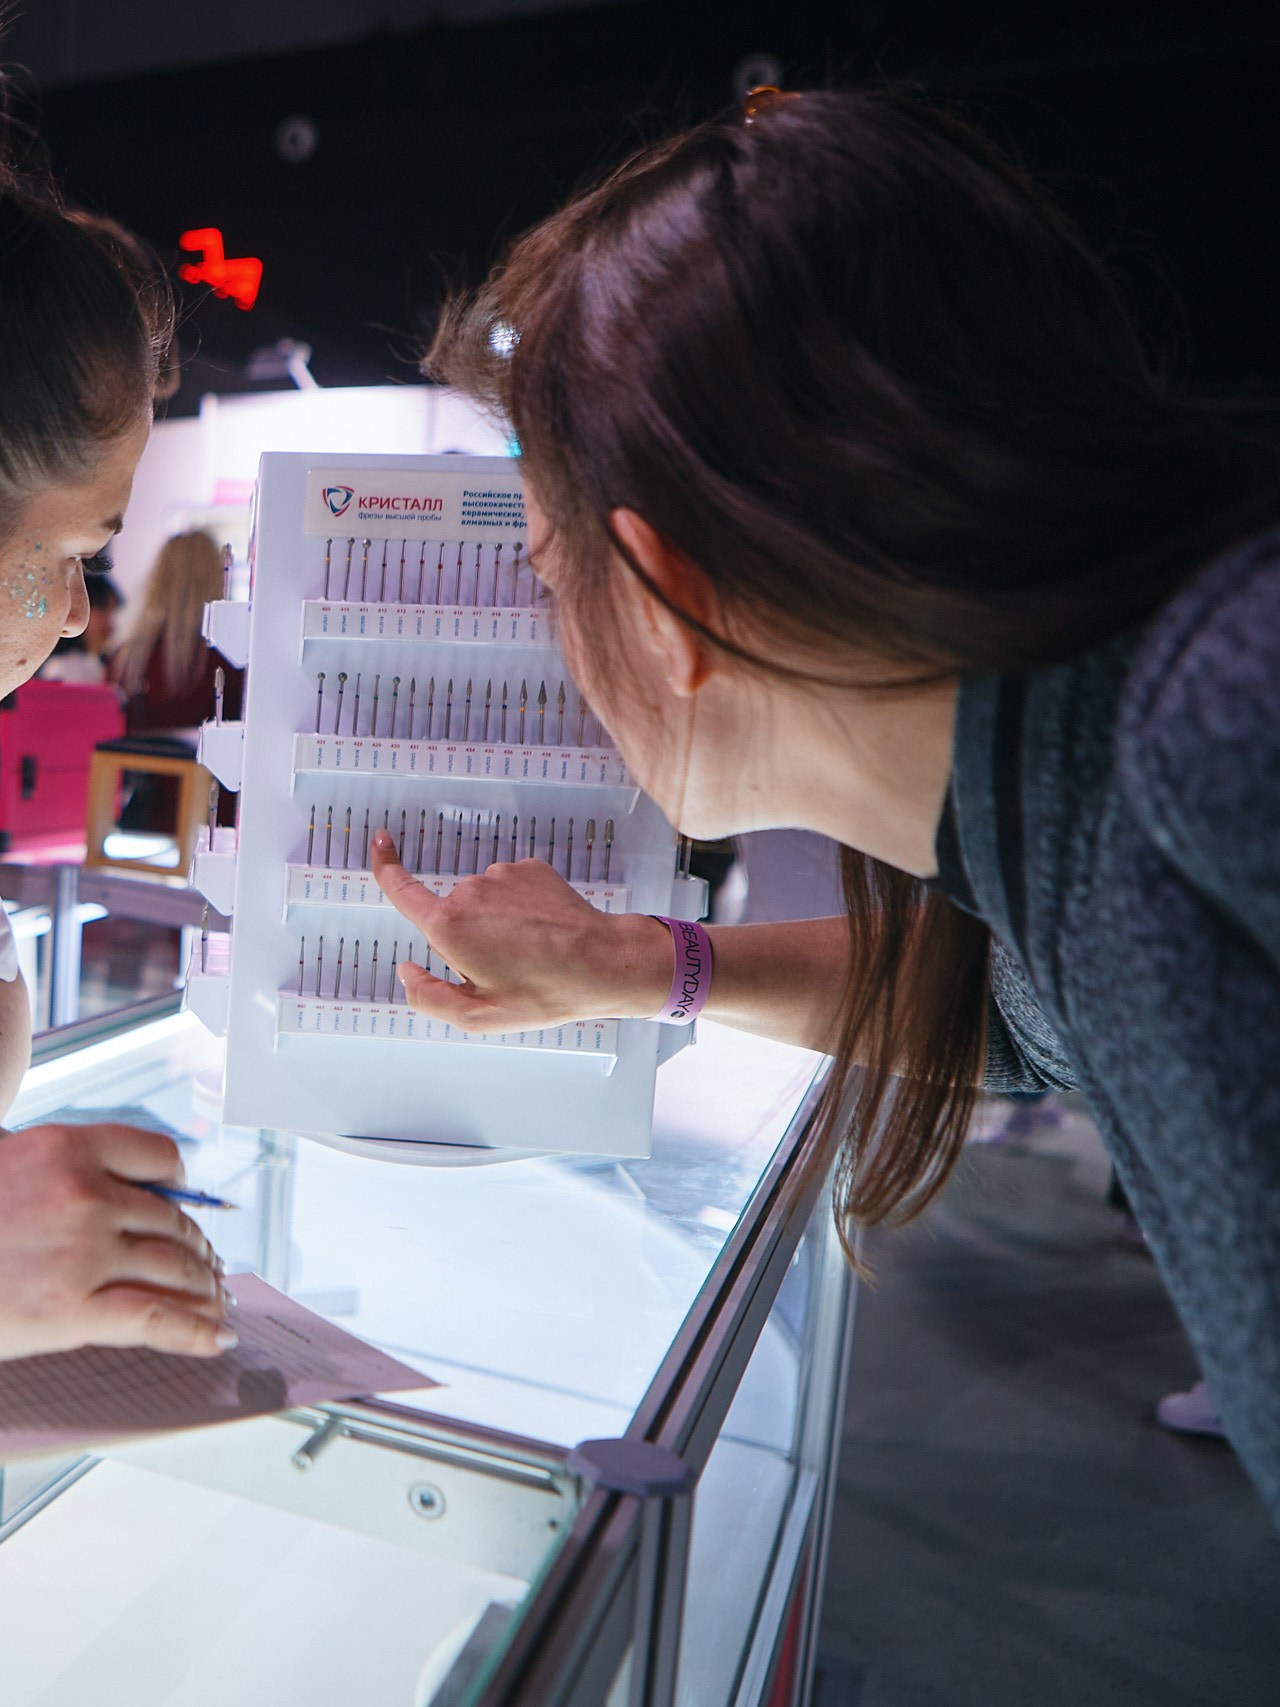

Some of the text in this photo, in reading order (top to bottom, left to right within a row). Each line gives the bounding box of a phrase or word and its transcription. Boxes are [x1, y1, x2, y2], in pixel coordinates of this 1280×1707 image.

[463, 490, 512, 499] Российское
[358, 496, 443, 511] КРИСТАЛЛ
[358, 512, 442, 522] фрезы высшей пробы
[461, 519, 503, 528] алмазных
[676, 922, 701, 1013] BEAUTYDAY
